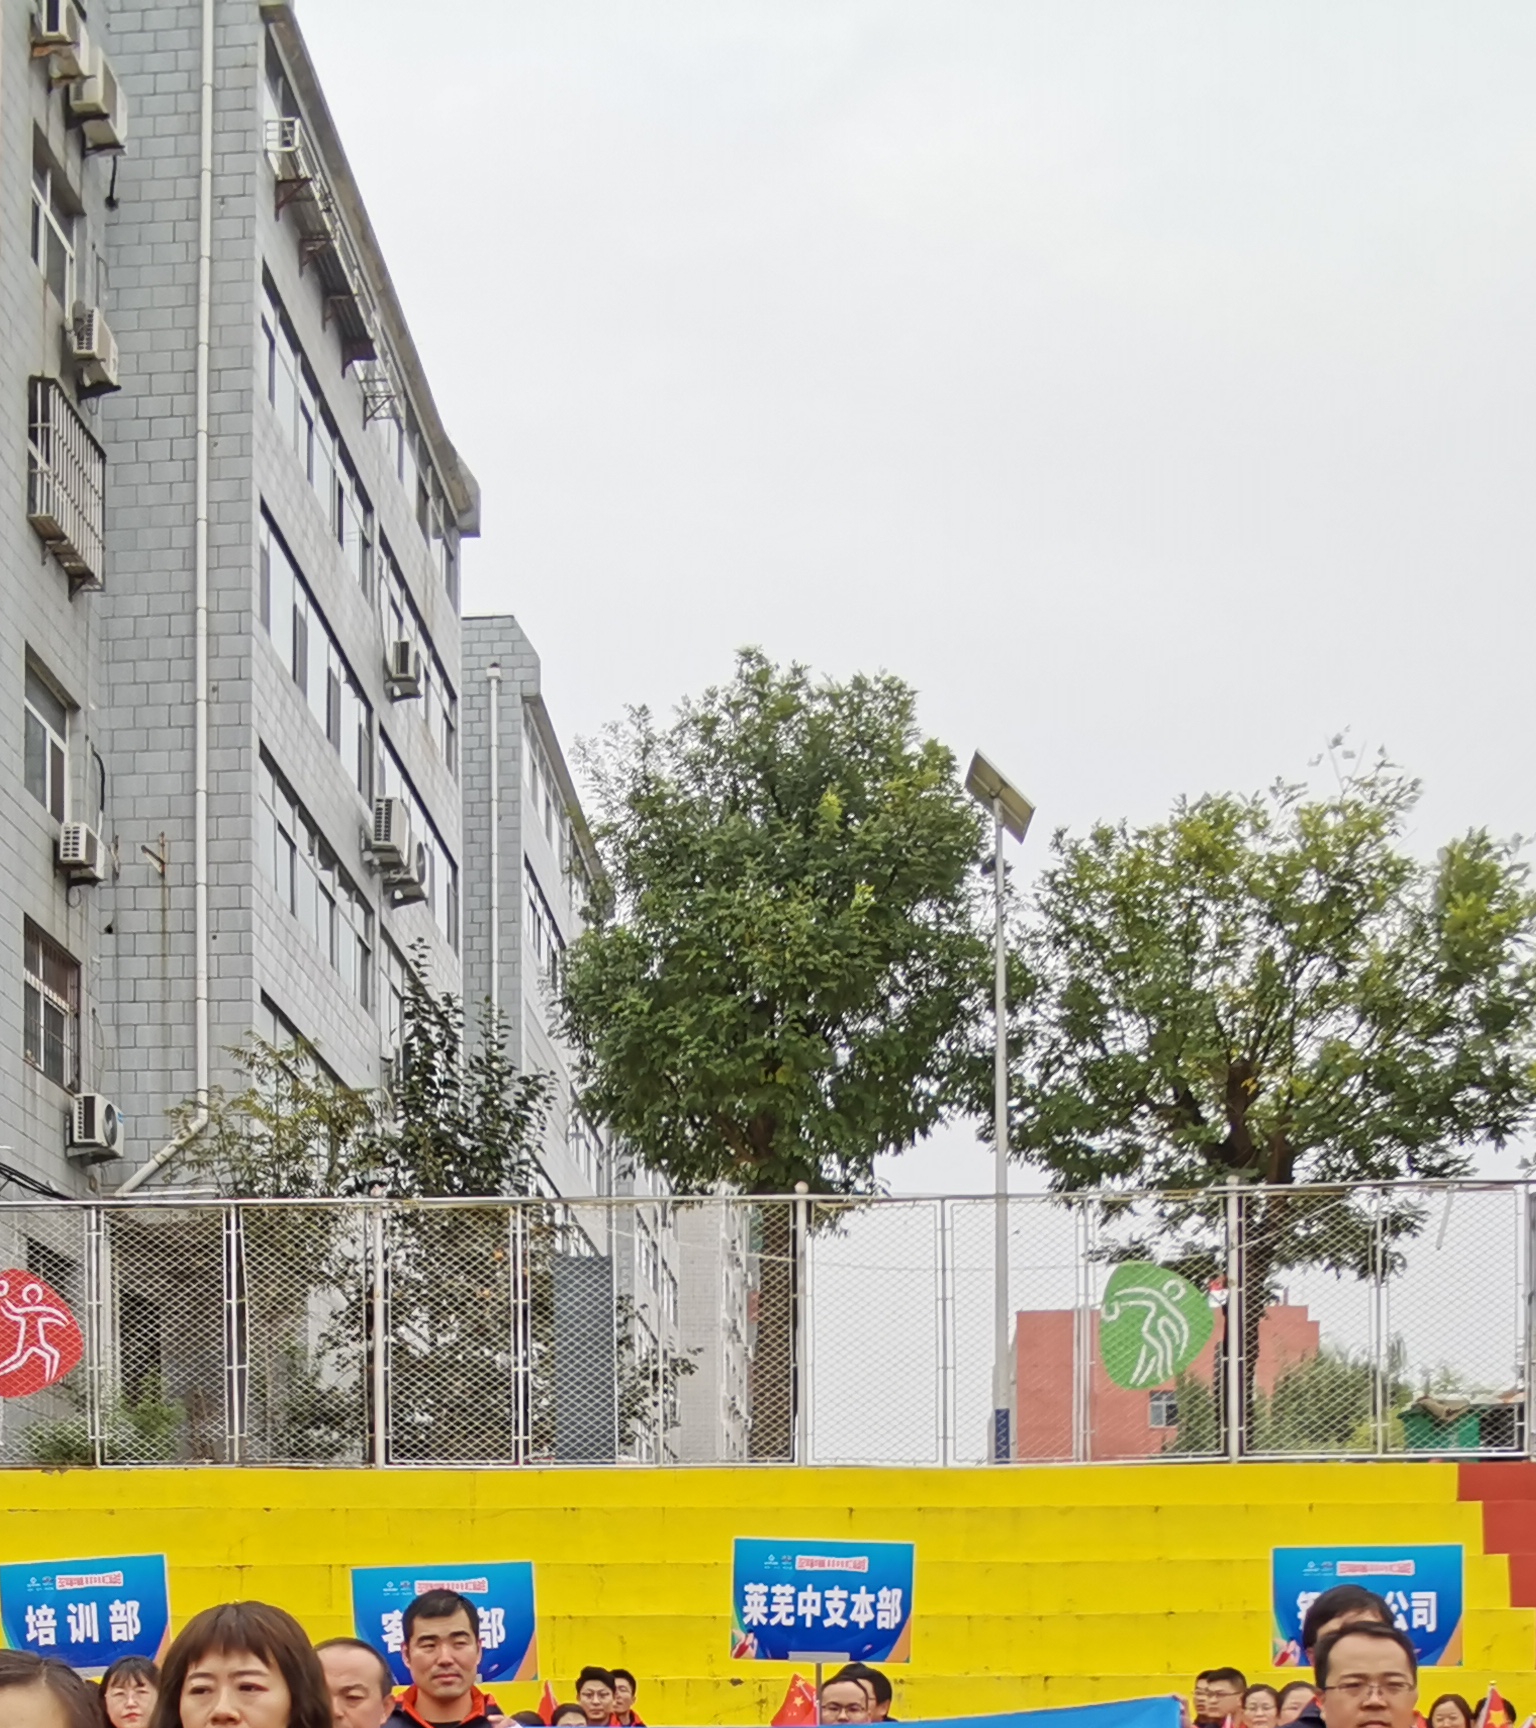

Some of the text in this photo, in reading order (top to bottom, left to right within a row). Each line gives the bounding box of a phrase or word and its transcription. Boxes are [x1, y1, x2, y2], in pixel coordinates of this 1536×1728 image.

[24, 1598, 142, 1647] 培训部
[742, 1581, 903, 1630] 莱芜中支本部
[380, 1606, 507, 1655] 客部
